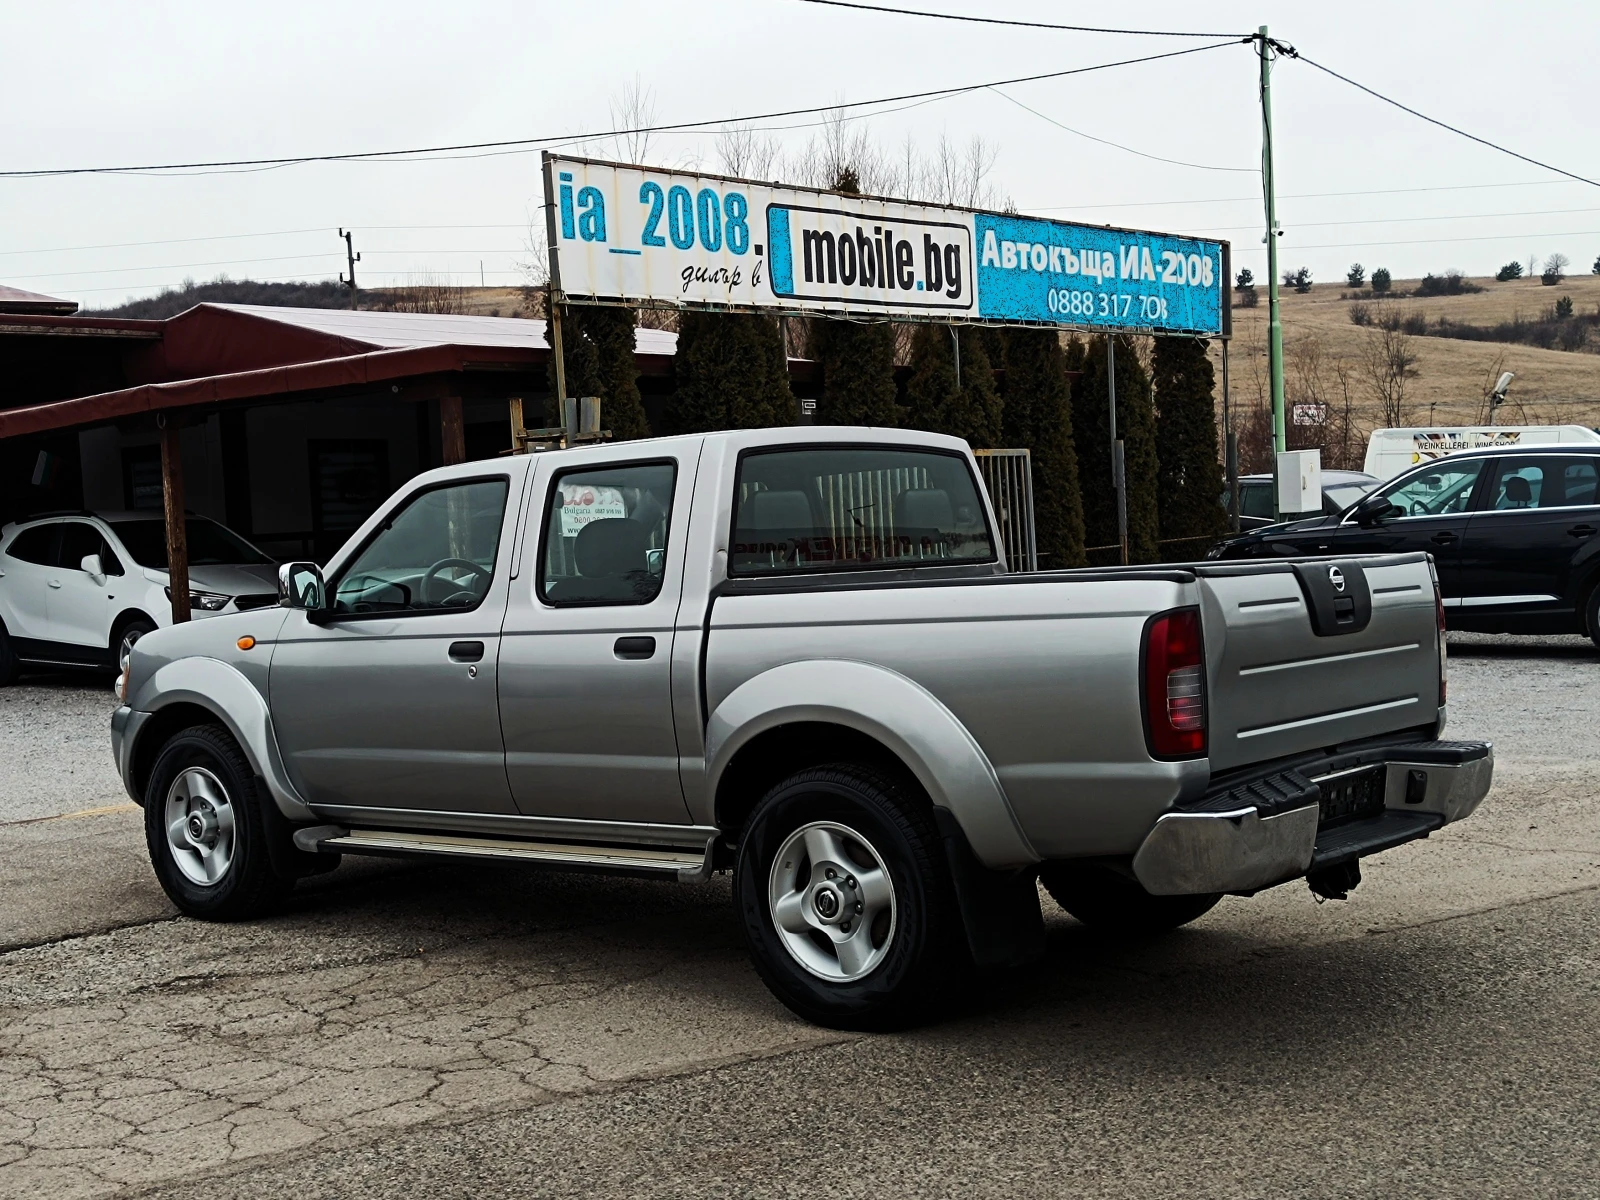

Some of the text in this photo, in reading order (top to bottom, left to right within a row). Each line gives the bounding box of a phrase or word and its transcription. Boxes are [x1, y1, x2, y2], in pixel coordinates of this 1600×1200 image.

[802, 226, 962, 299] mobile.bg
[981, 229, 1115, 284] Автокъща
[681, 265, 742, 293] дилър
[1048, 289, 1168, 320] 0888 317 708
[1417, 441, 1469, 450] WEINKELLEREI
[564, 506, 591, 516] Bulgaria
